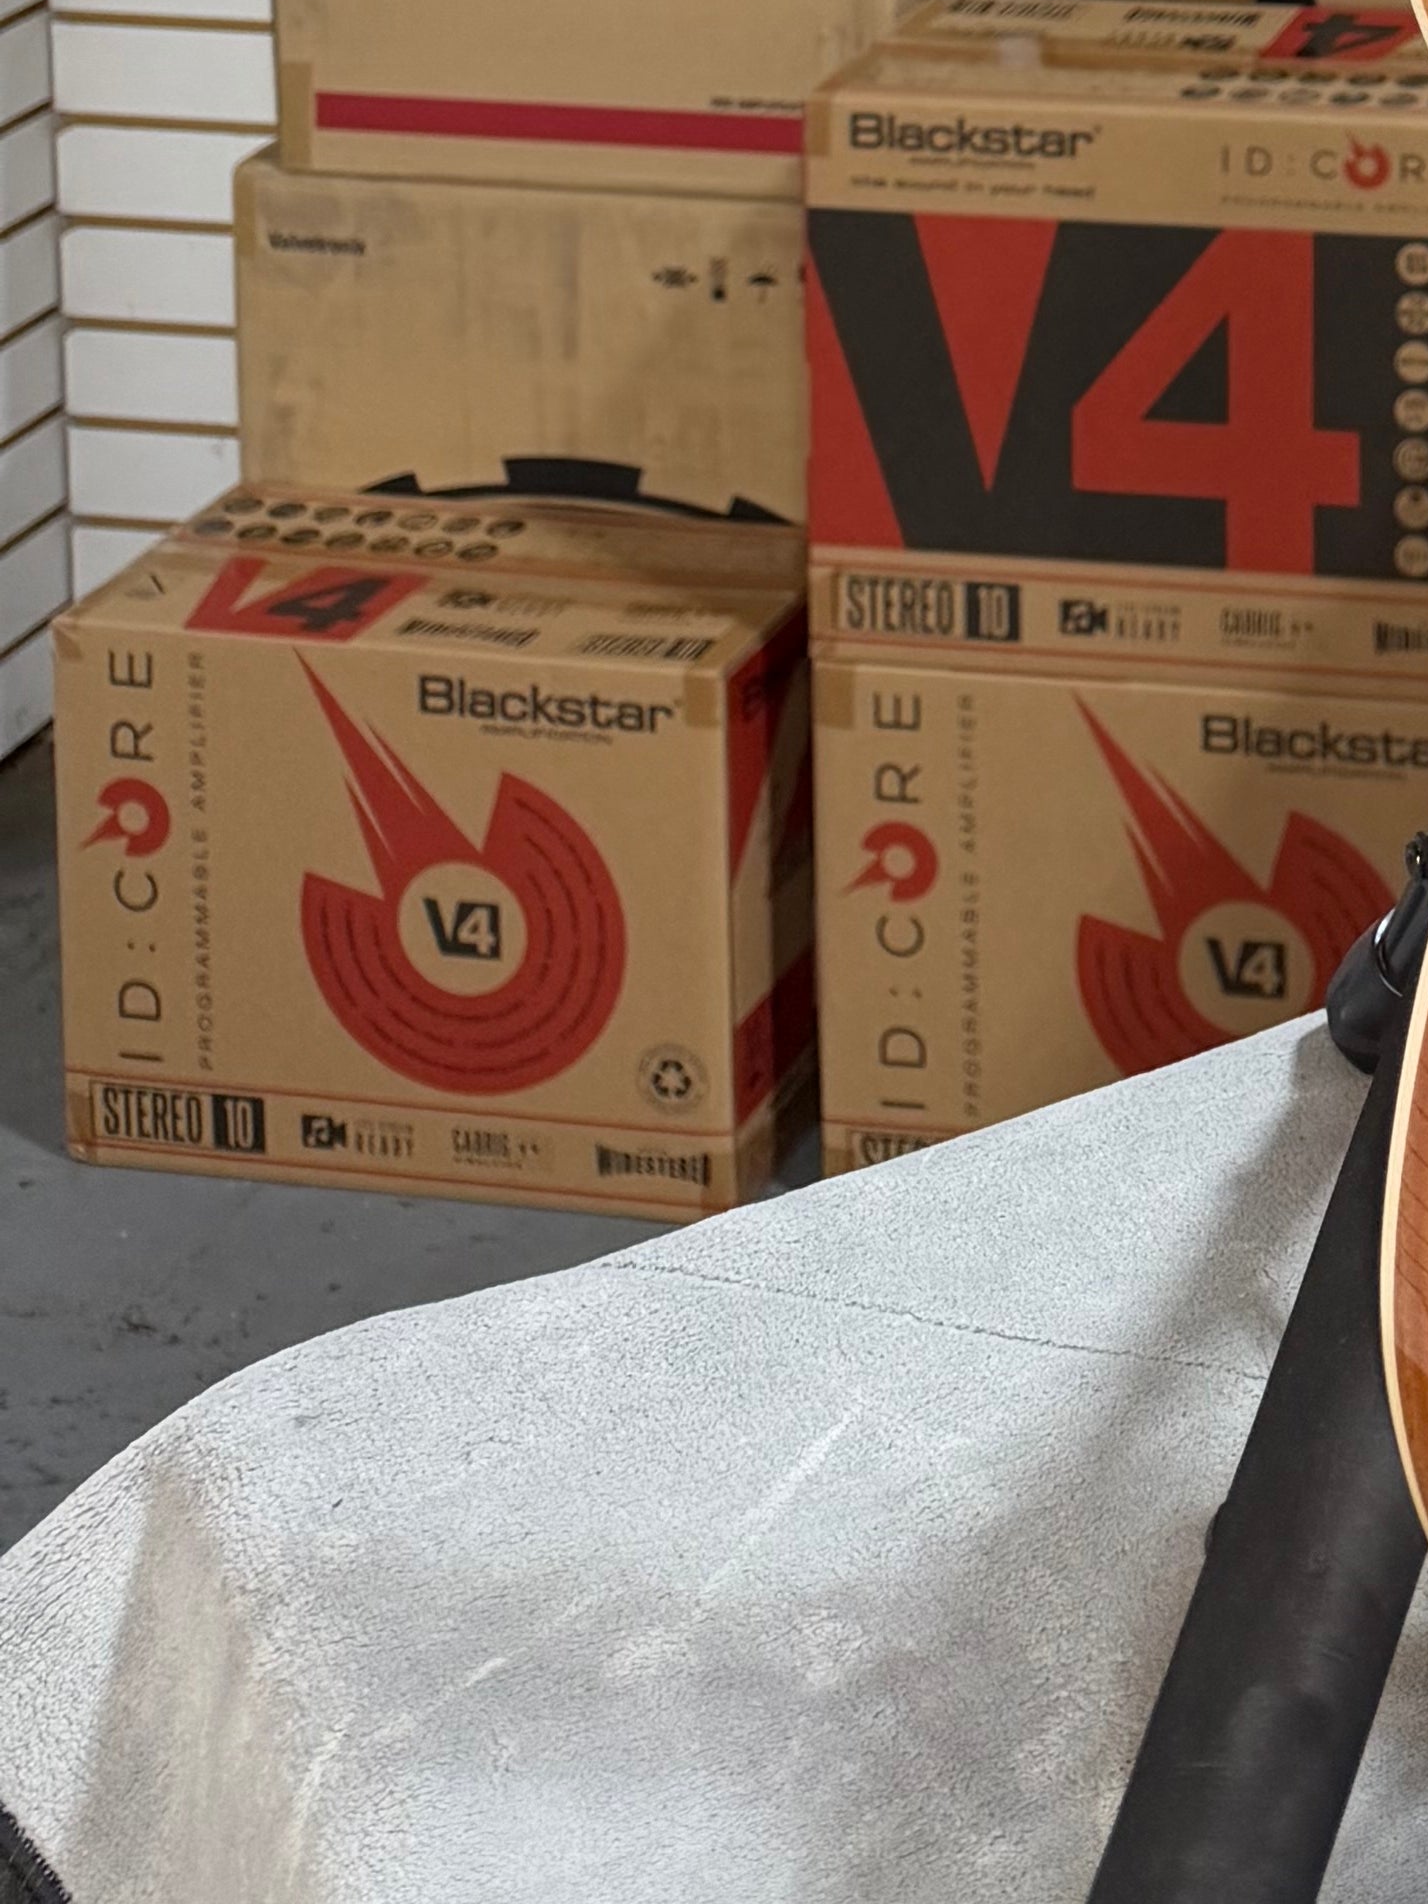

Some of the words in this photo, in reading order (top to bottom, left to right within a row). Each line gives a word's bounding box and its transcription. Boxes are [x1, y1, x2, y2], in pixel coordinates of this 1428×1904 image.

[849, 111, 1095, 159] Blackstar
[806, 206, 1361, 576] V4
[844, 574, 957, 638] STEREO
[976, 584, 1013, 639] 10
[187, 651, 207, 813] AMPLIFIER
[418, 672, 674, 734] Blackstar
[957, 695, 978, 854] AMPLIFIER
[192, 828, 214, 1071] PROGRAMMABLE
[423, 896, 501, 961] V4
[958, 872, 982, 1119] PROGRAMMABLE
[1205, 936, 1287, 999] V4
[102, 1085, 202, 1144] STEREO
[222, 1097, 255, 1150] 10
